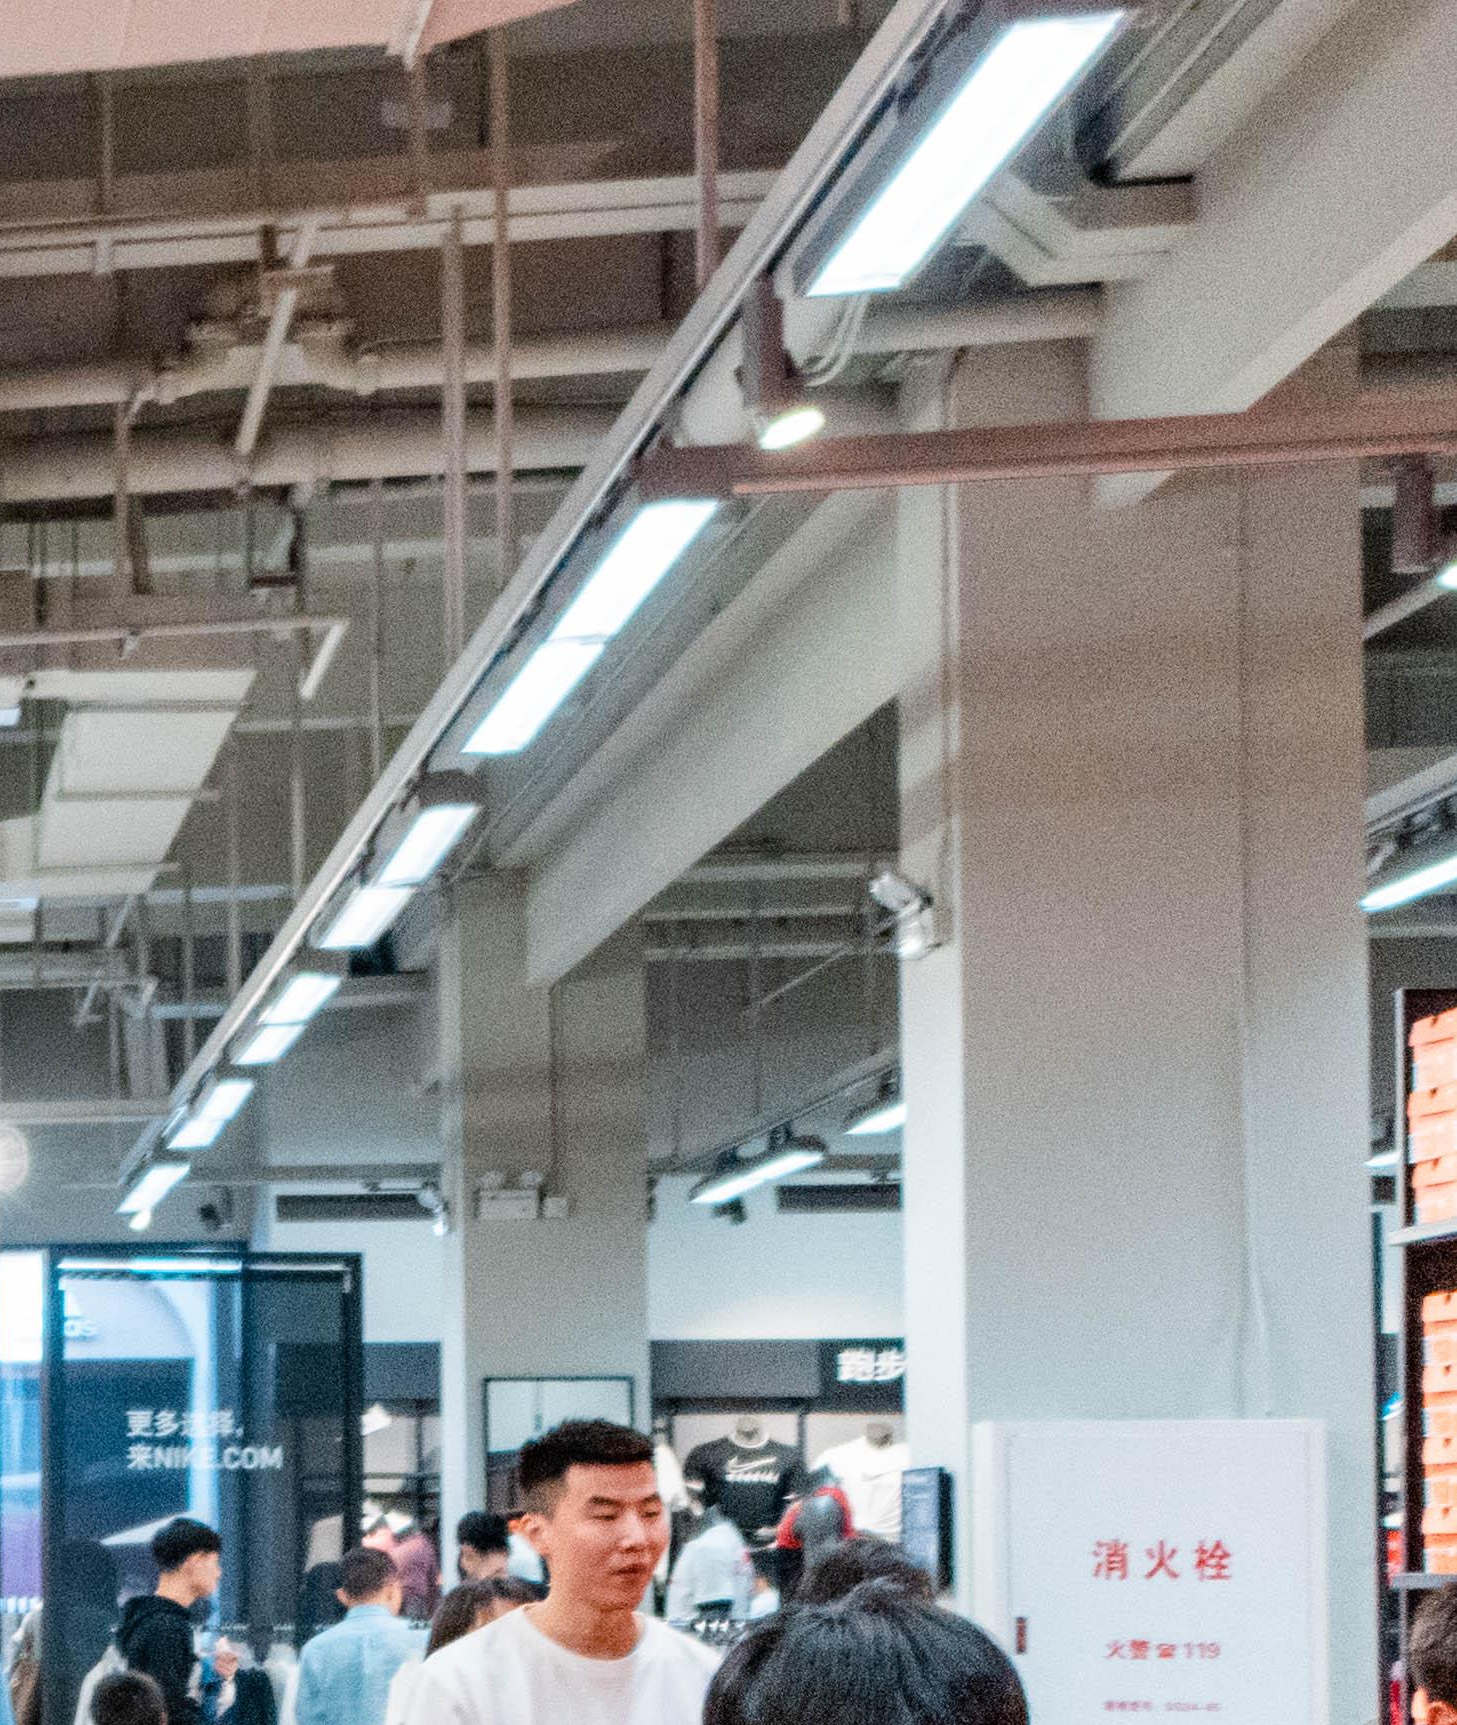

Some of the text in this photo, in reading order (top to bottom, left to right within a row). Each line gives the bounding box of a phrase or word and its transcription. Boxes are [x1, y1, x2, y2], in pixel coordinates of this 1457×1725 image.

[1091, 1538, 1232, 1581] 消火栓
[1105, 1639, 1222, 1660] 火警 119
